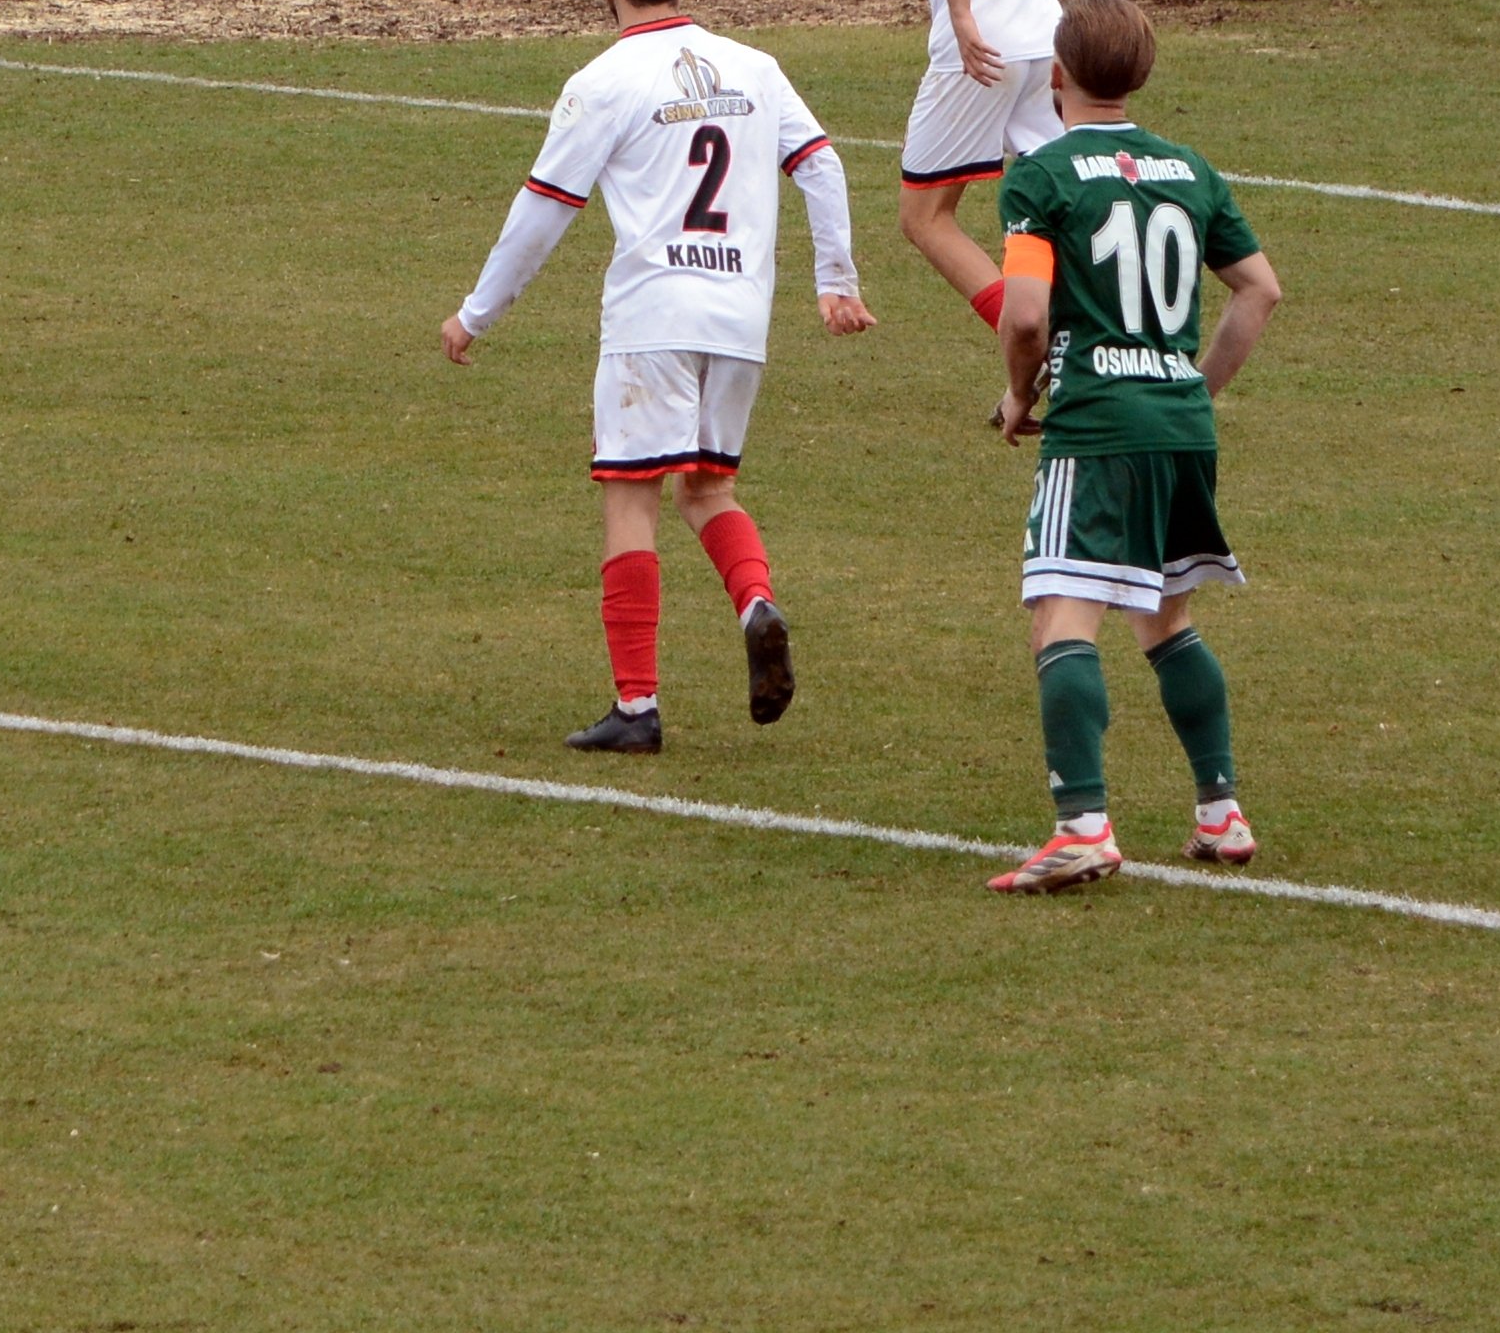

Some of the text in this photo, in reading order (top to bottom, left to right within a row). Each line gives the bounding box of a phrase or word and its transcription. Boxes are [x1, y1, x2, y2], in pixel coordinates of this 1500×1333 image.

[682, 124, 731, 234] 2
[666, 241, 743, 274] KADİR
[1091, 200, 1198, 335] 10
